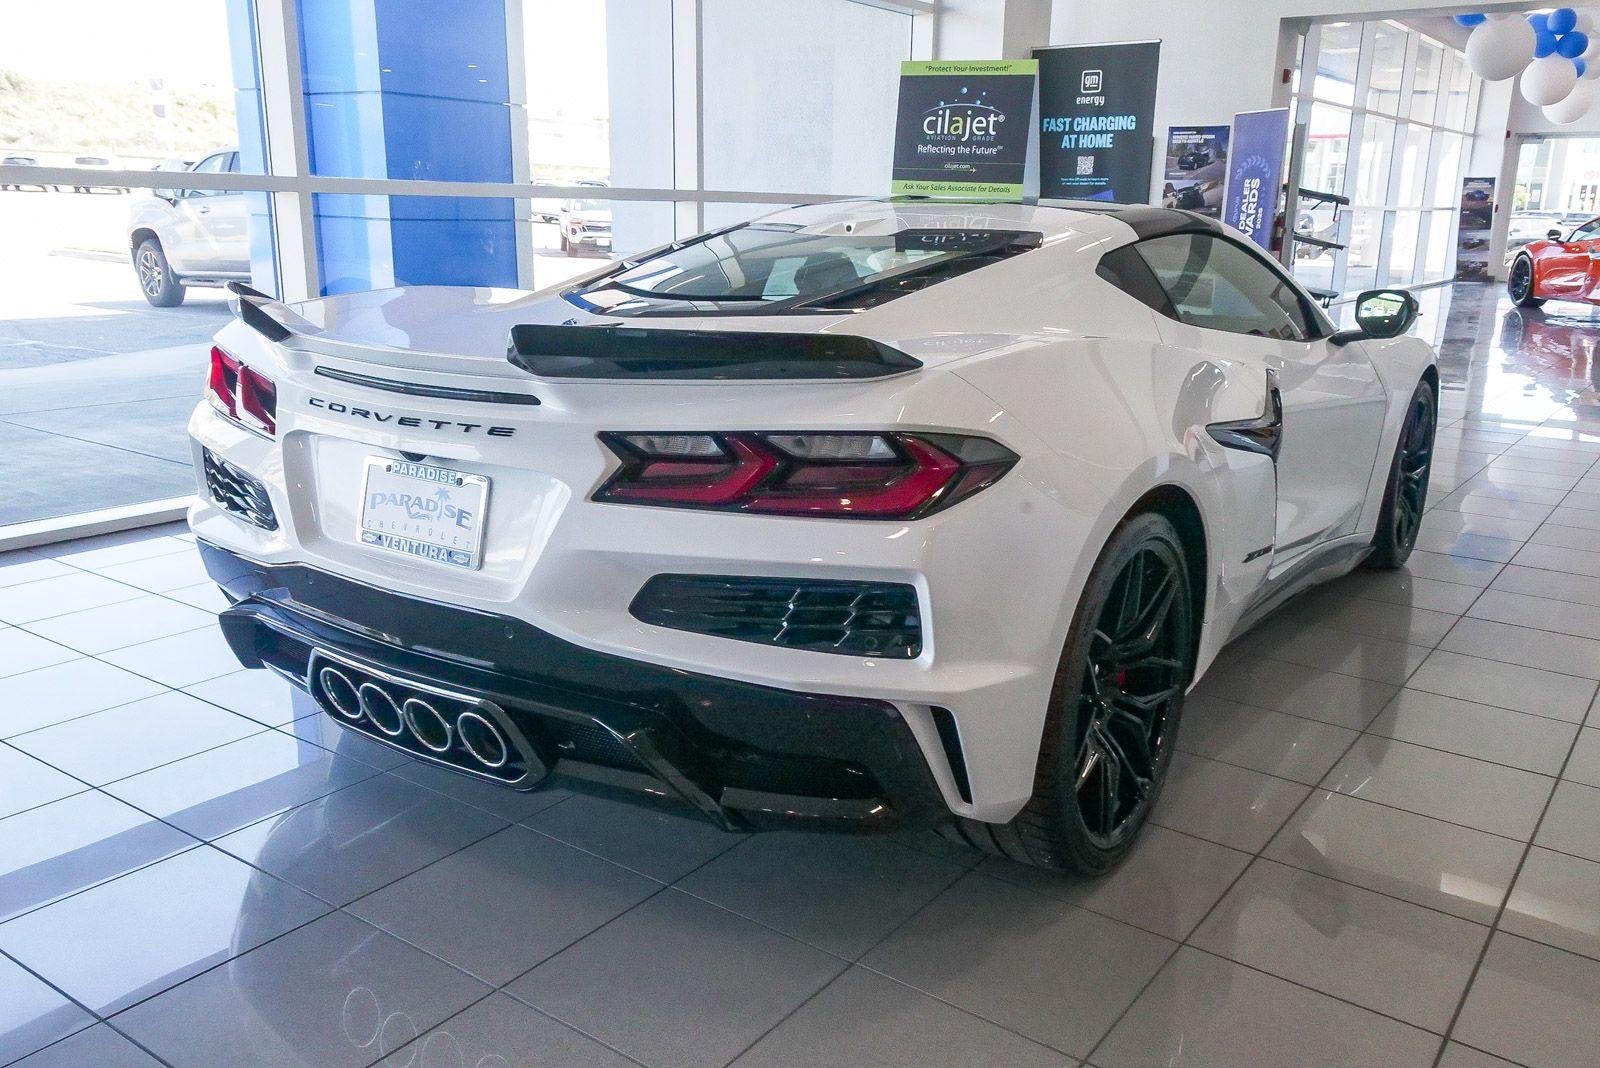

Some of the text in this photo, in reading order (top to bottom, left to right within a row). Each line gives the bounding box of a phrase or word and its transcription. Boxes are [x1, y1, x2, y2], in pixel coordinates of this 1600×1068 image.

[953, 65, 969, 73] Your
[1084, 75, 1099, 88] gm
[1076, 95, 1105, 106] energy
[1043, 115, 1137, 132] FAST CHARGING
[1061, 133, 1114, 149] AT HOME
[917, 144, 956, 156] Reflecting
[957, 144, 970, 154] the
[916, 183, 930, 191] Your
[930, 184, 946, 192] Sales
[946, 184, 977, 193] Associate
[977, 185, 987, 193] for
[987, 186, 1011, 194] Details
[1238, 178, 1252, 230] DEALER
[309, 396, 517, 438] CORVETTE
[391, 461, 458, 484] PARADISE
[369, 487, 474, 532] PARADISE
[381, 534, 449, 561] VENTURA
